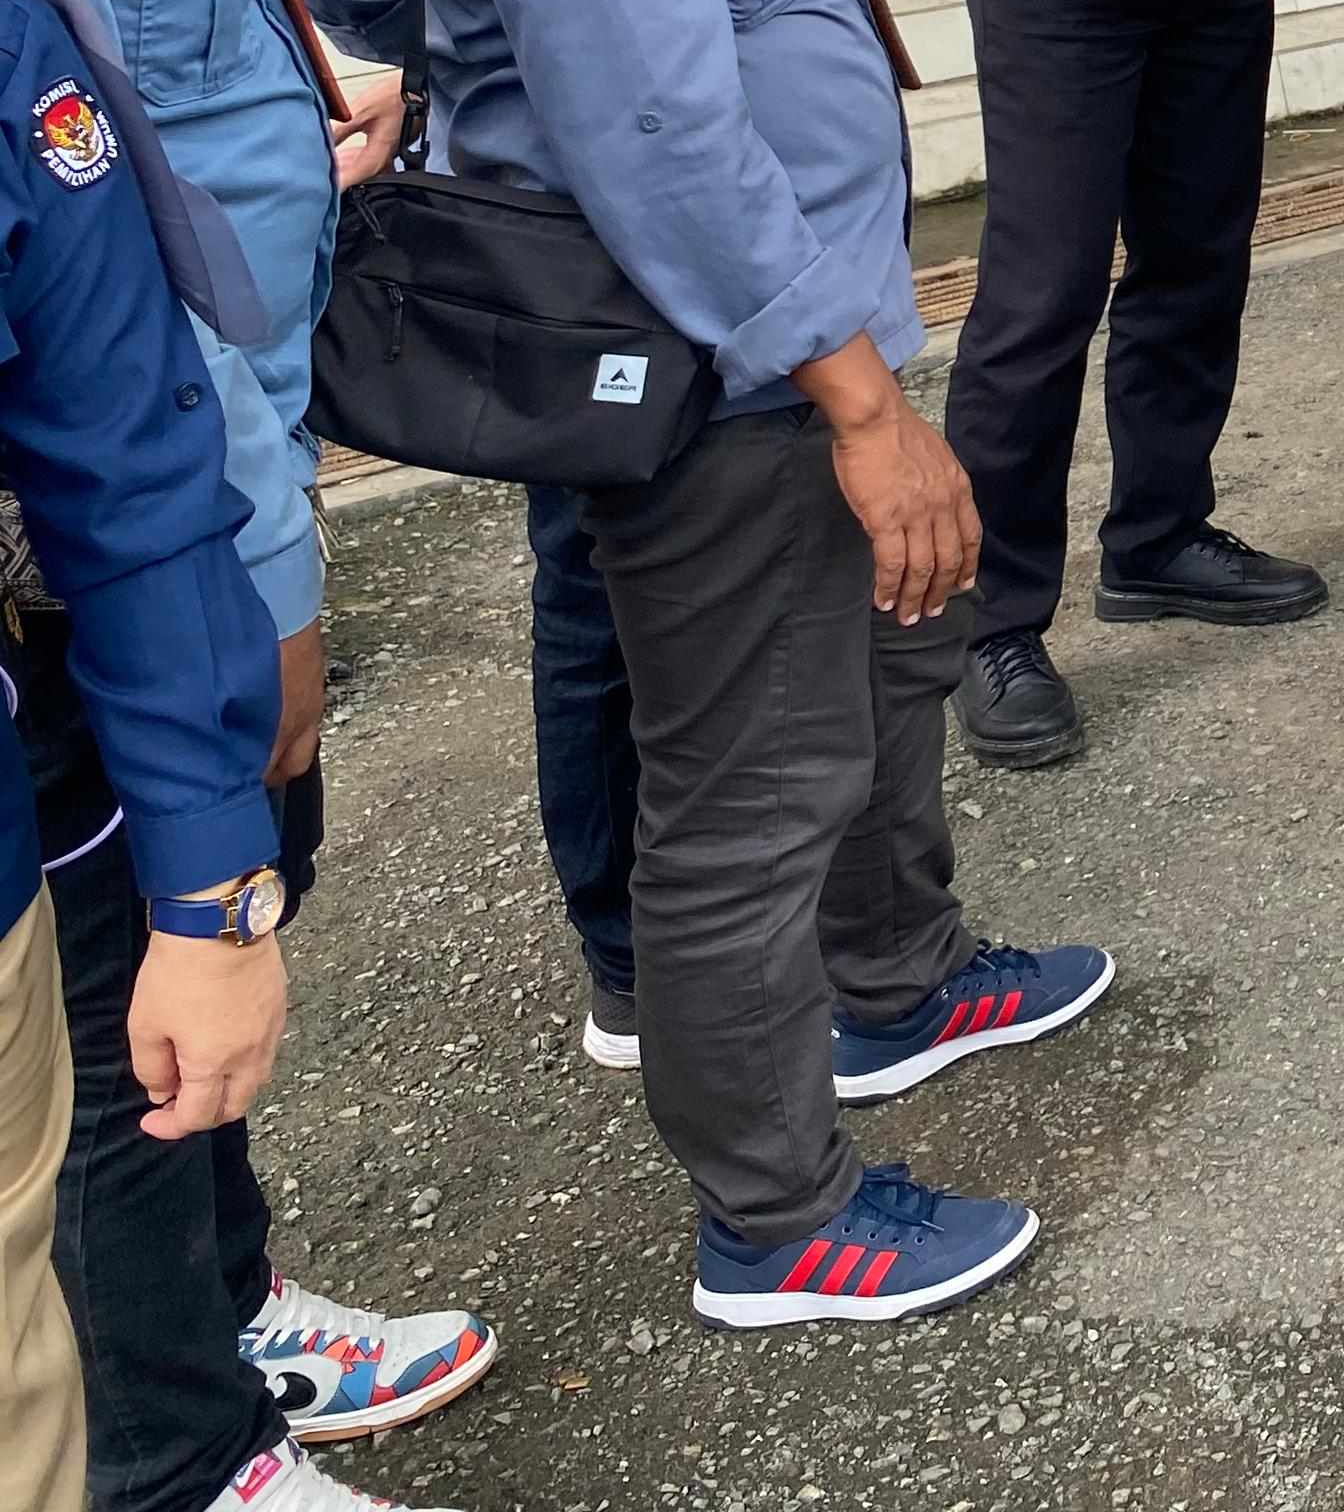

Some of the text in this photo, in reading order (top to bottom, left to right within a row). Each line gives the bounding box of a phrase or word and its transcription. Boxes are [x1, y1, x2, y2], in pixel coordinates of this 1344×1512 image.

[33, 80, 80, 117] KOMISI
[41, 110, 118, 186] PEMILIHAN UMUM
